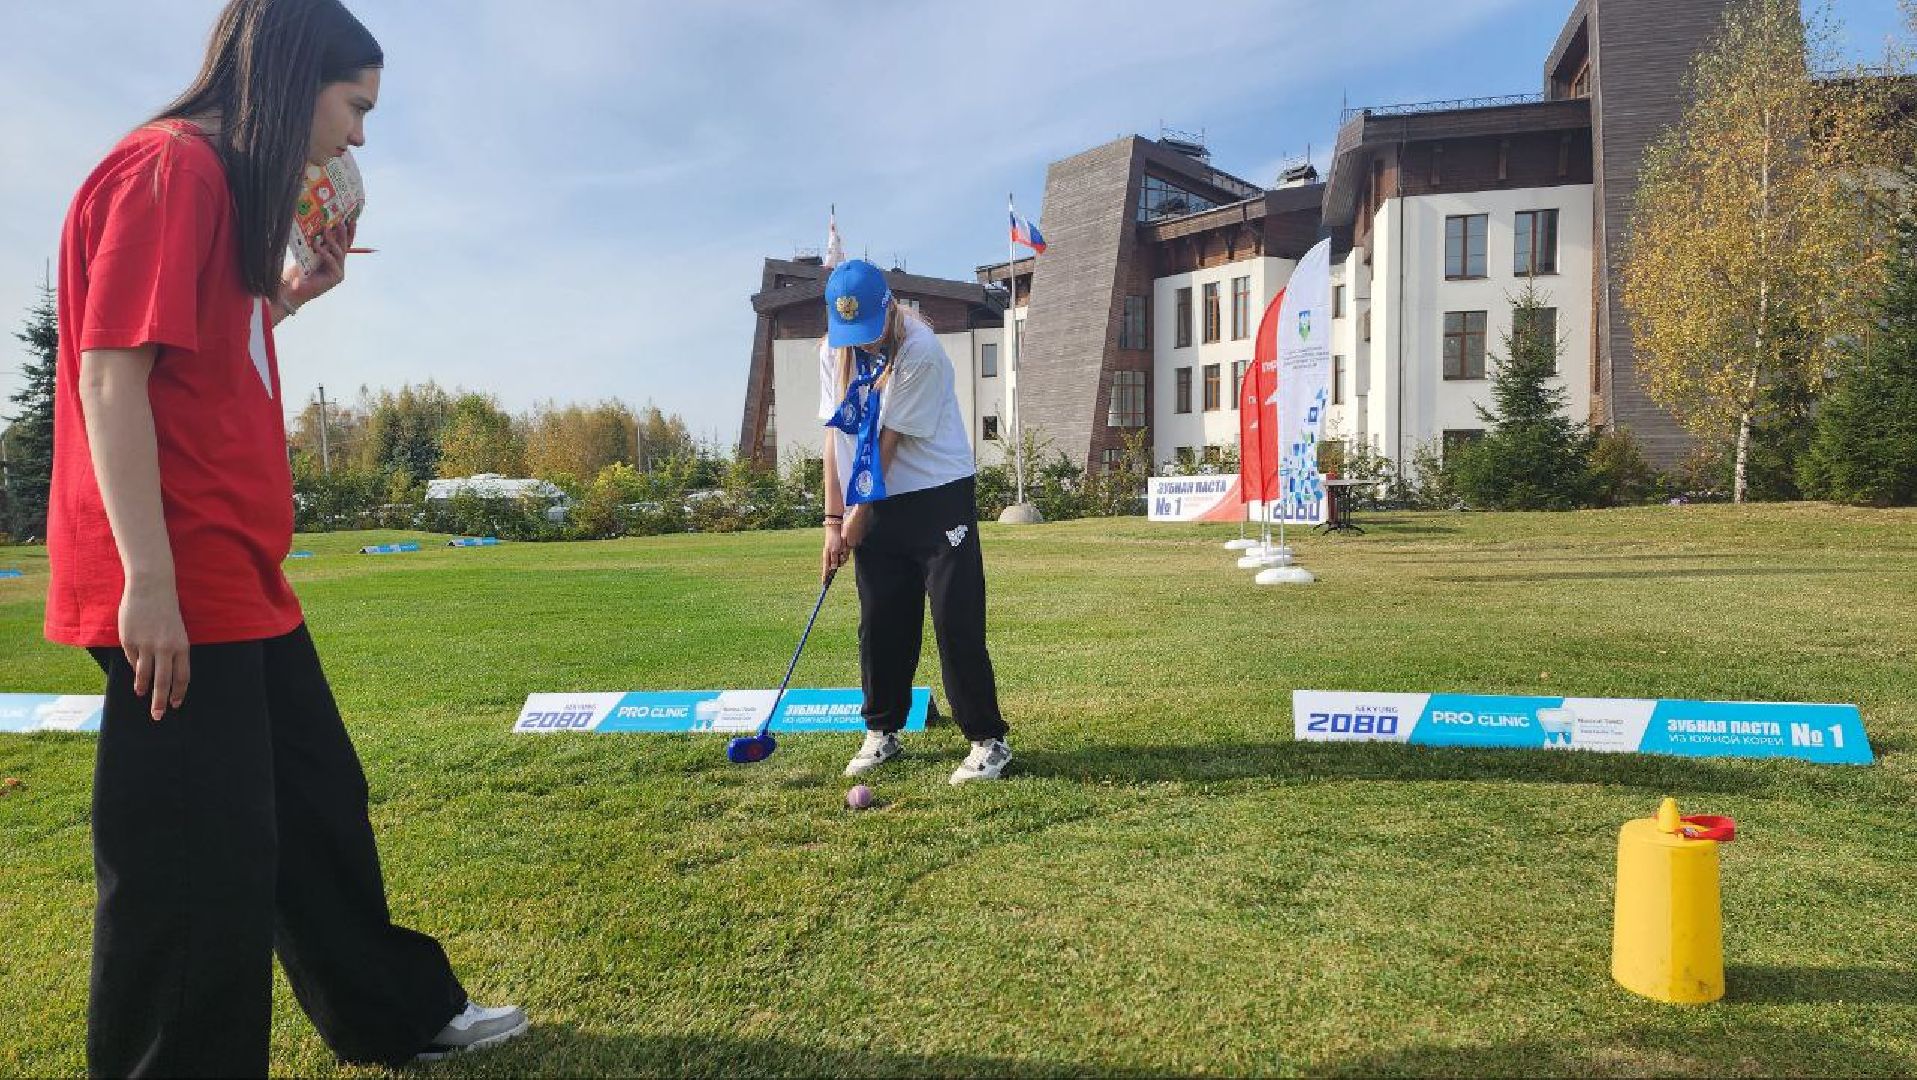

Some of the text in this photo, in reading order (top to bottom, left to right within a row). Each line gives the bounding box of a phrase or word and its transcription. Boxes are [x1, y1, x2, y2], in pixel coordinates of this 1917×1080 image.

[1157, 479, 1227, 494] ЗУБНАЯ ПАСТА
[617, 706, 689, 718] PRO CLINIC
[784, 703, 829, 716] ЗУБНАЯ
[520, 711, 594, 728] 2080
[1307, 713, 1399, 734] 2080
[1432, 710, 1531, 728] PRO CLINIC
[1667, 719, 1780, 736] ЗУБНАЯ ПАСТА
[1669, 733, 1784, 747] ИЗ ЮЖНОЙ КОРЕИ
